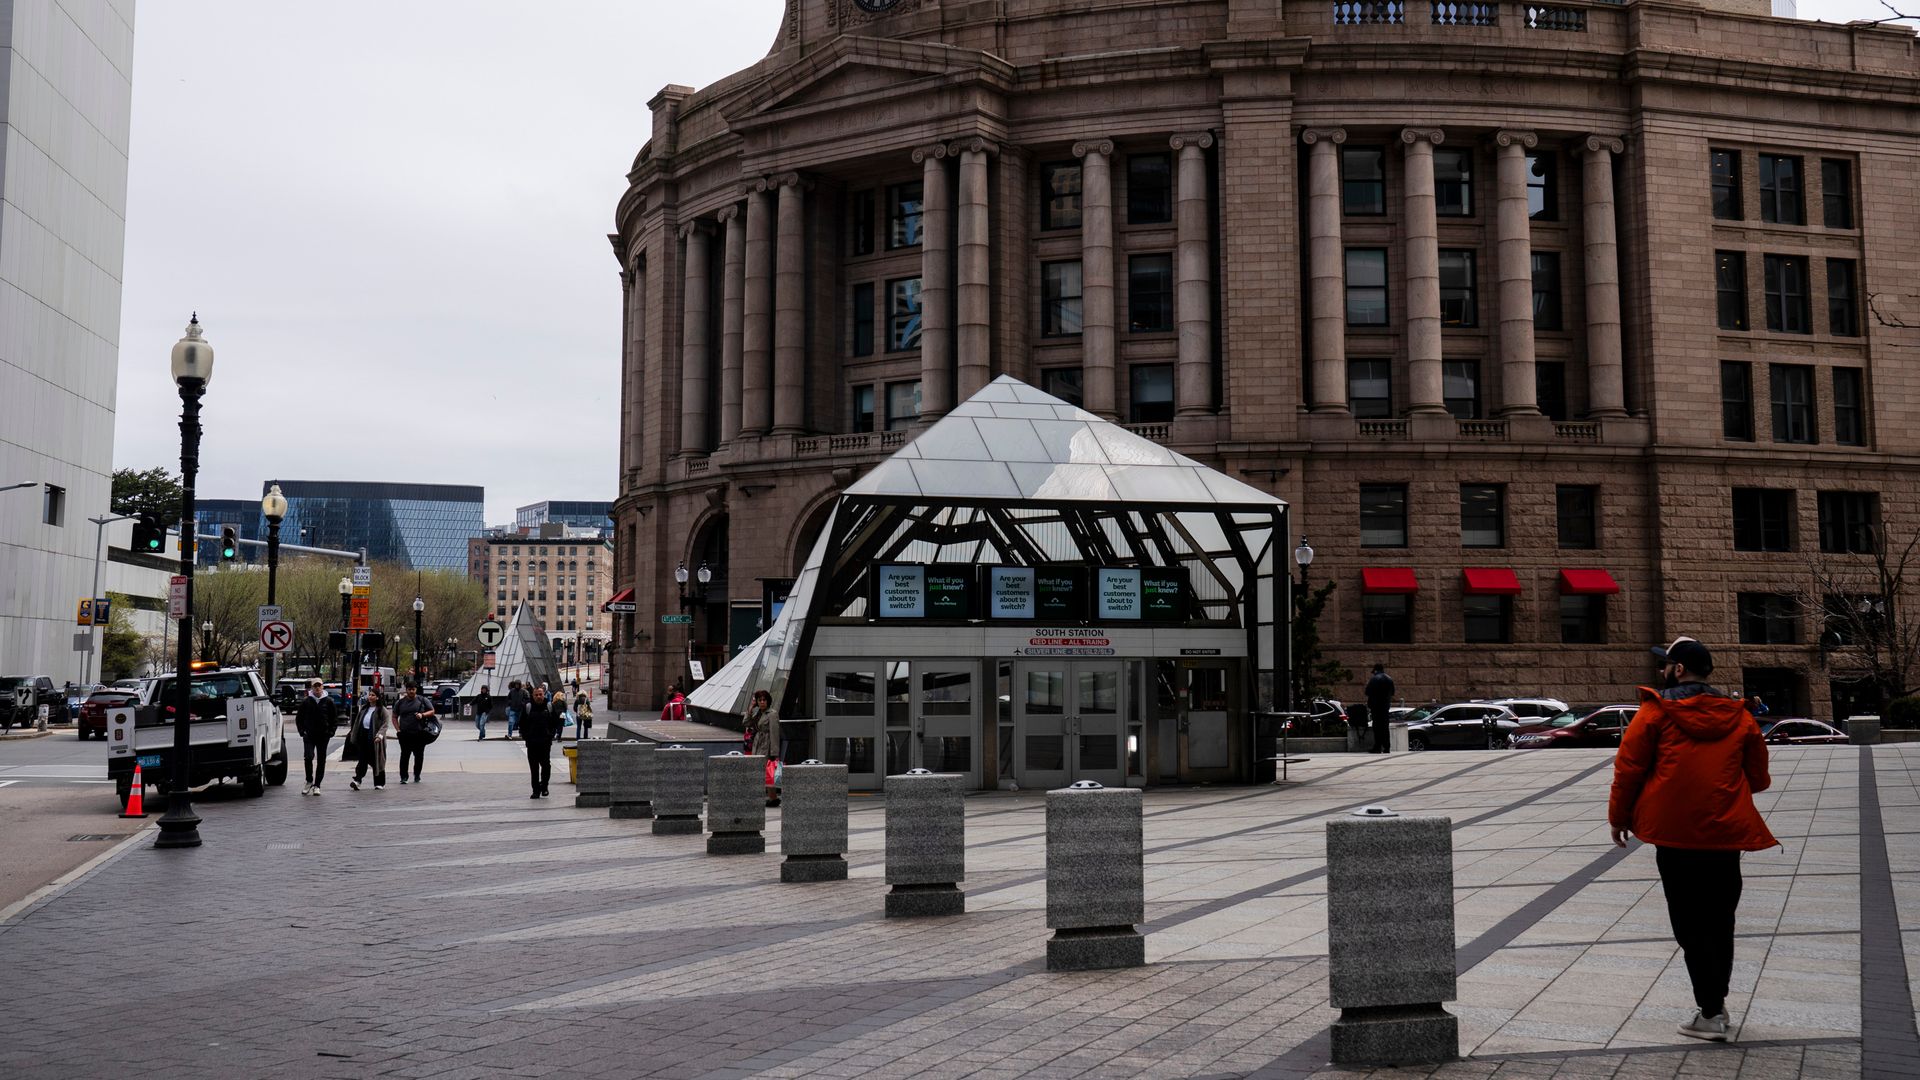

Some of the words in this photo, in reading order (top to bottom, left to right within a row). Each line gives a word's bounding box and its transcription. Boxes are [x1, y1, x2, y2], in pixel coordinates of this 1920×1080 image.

[928, 584, 942, 592] just
[482, 628, 500, 643] T
[1035, 629, 1066, 637] SOUTH
[1068, 629, 1104, 637] STATION
